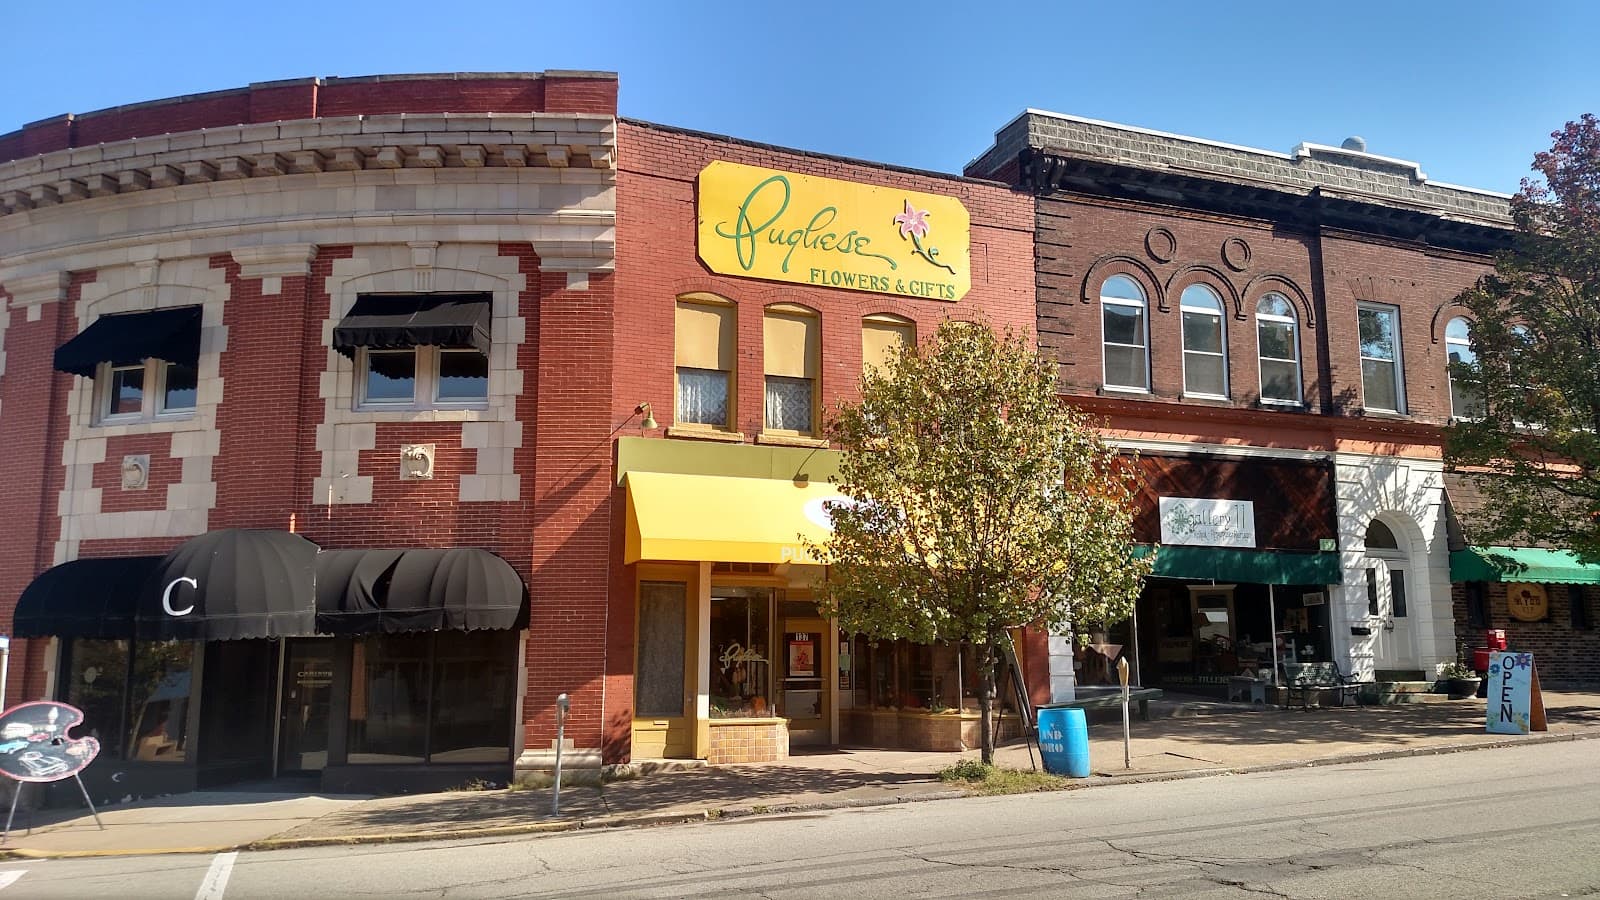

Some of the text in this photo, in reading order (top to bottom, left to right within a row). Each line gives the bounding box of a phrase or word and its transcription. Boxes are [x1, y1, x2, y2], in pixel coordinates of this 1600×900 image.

[810, 268, 955, 299] FLOWERS & GIFTS
[1187, 508, 1231, 531] gallery
[162, 576, 198, 616] C
[795, 632, 809, 641] 137
[1500, 655, 1515, 723] OPEN
